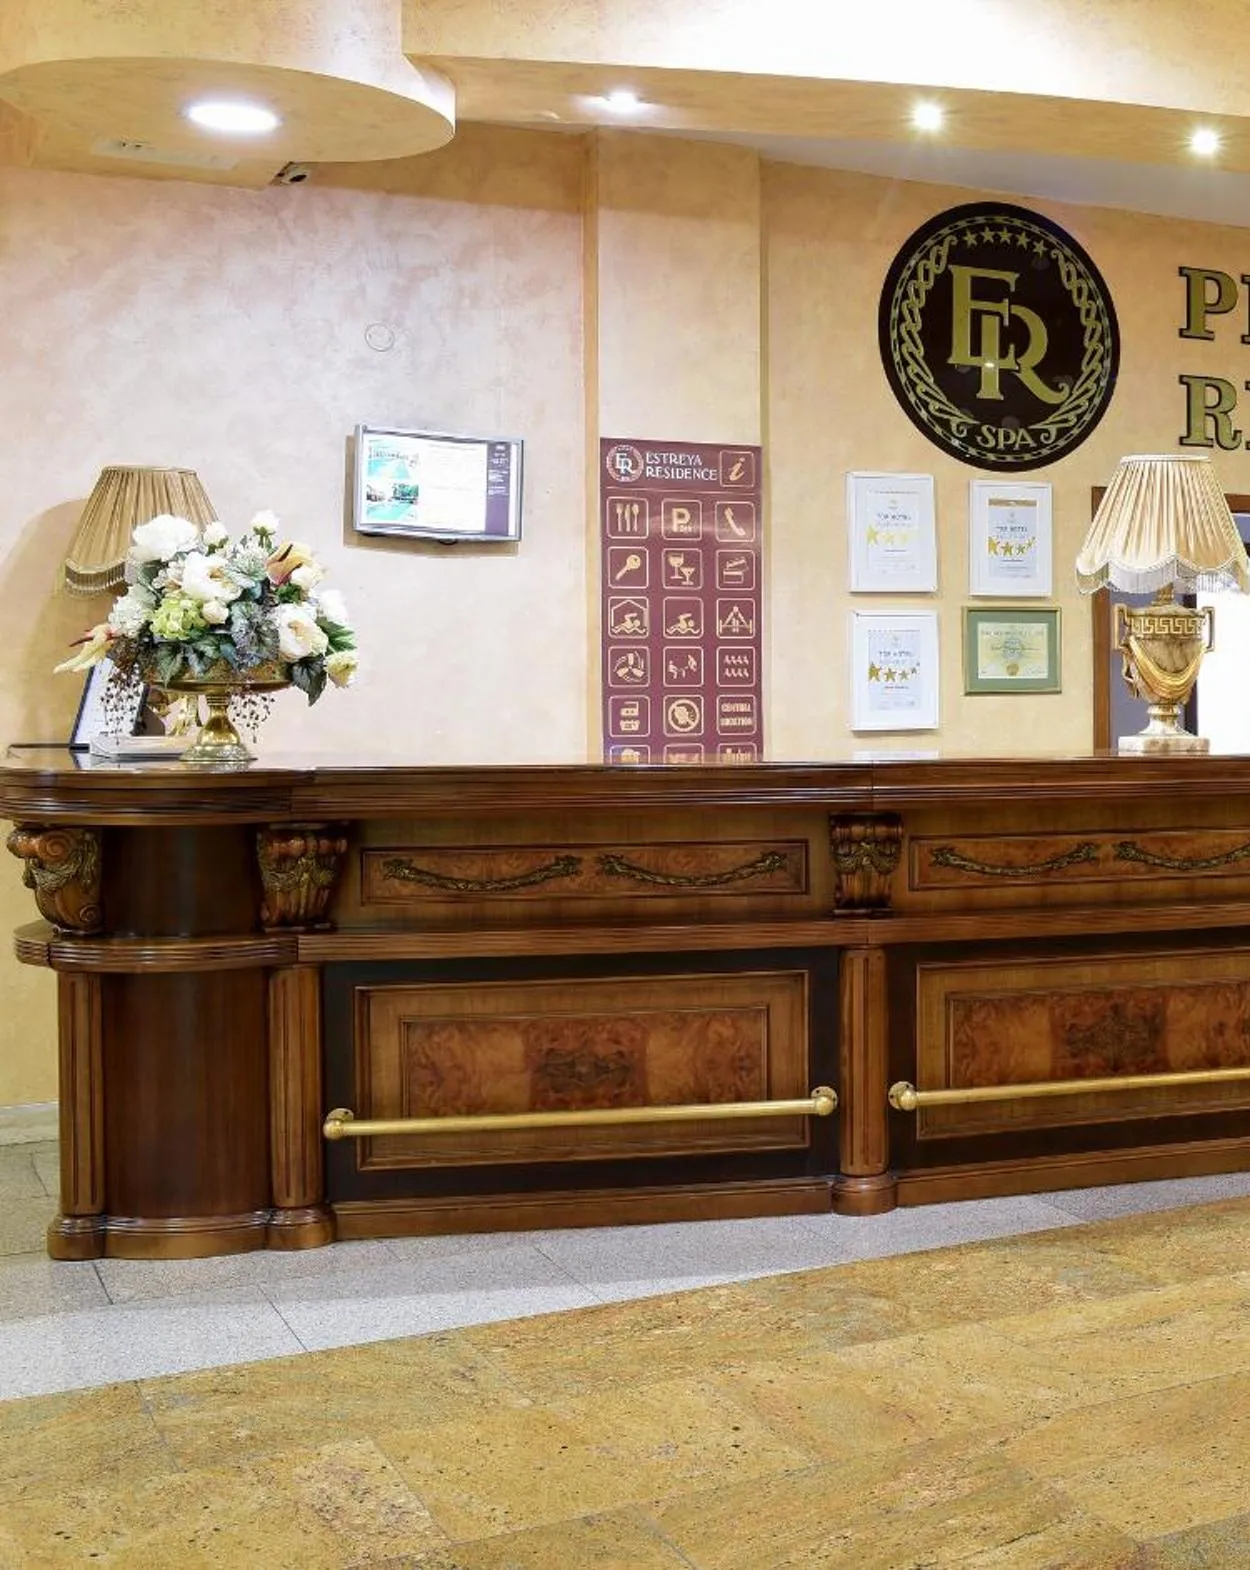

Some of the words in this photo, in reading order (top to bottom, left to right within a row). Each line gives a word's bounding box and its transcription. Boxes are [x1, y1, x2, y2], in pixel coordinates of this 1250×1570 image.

[976, 424, 1034, 450] SPA
[645, 452, 703, 466] ESTREYA
[645, 466, 718, 481] RESIDENCE
[671, 508, 691, 533] P
